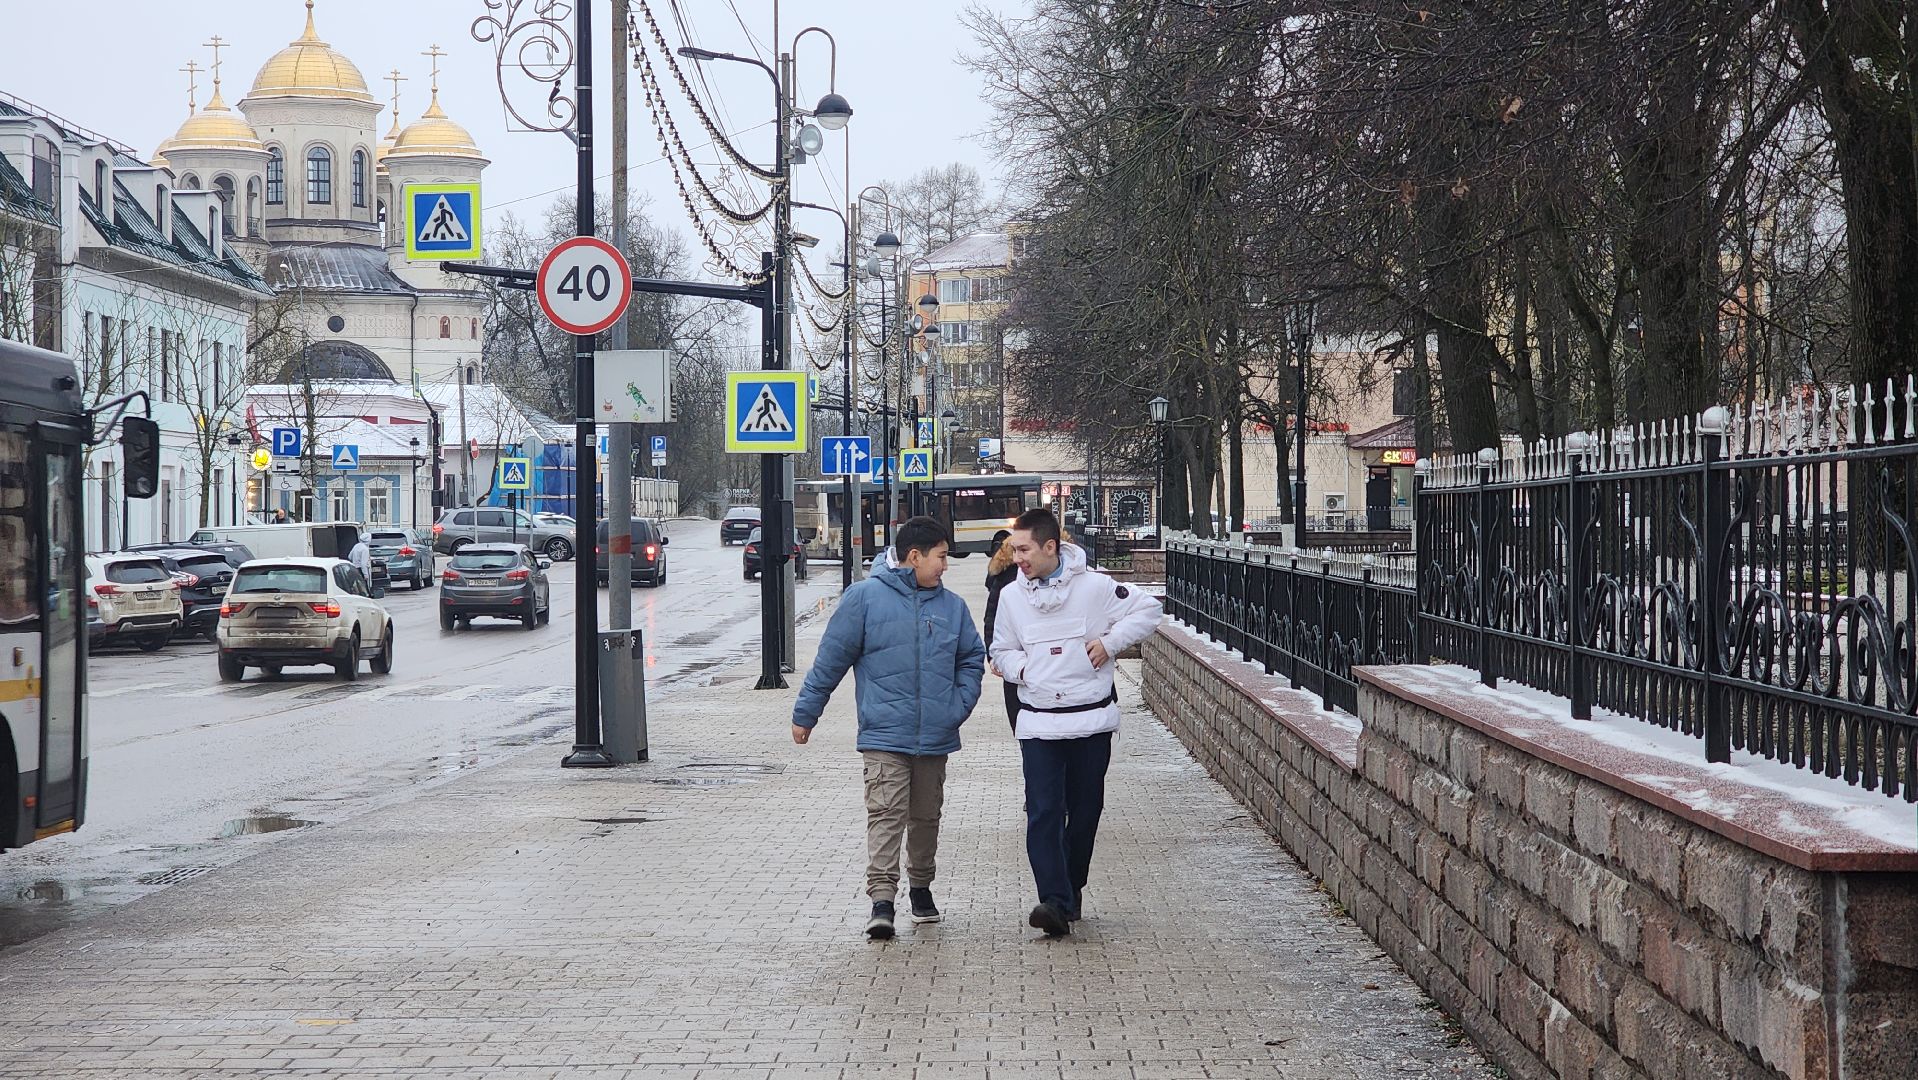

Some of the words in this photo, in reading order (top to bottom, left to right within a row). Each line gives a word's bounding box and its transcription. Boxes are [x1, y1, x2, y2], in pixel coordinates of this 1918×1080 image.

[556, 264, 611, 302] 40
[279, 430, 296, 454] P
[654, 437, 664, 450] P
[1402, 451, 1416, 462] МУ
